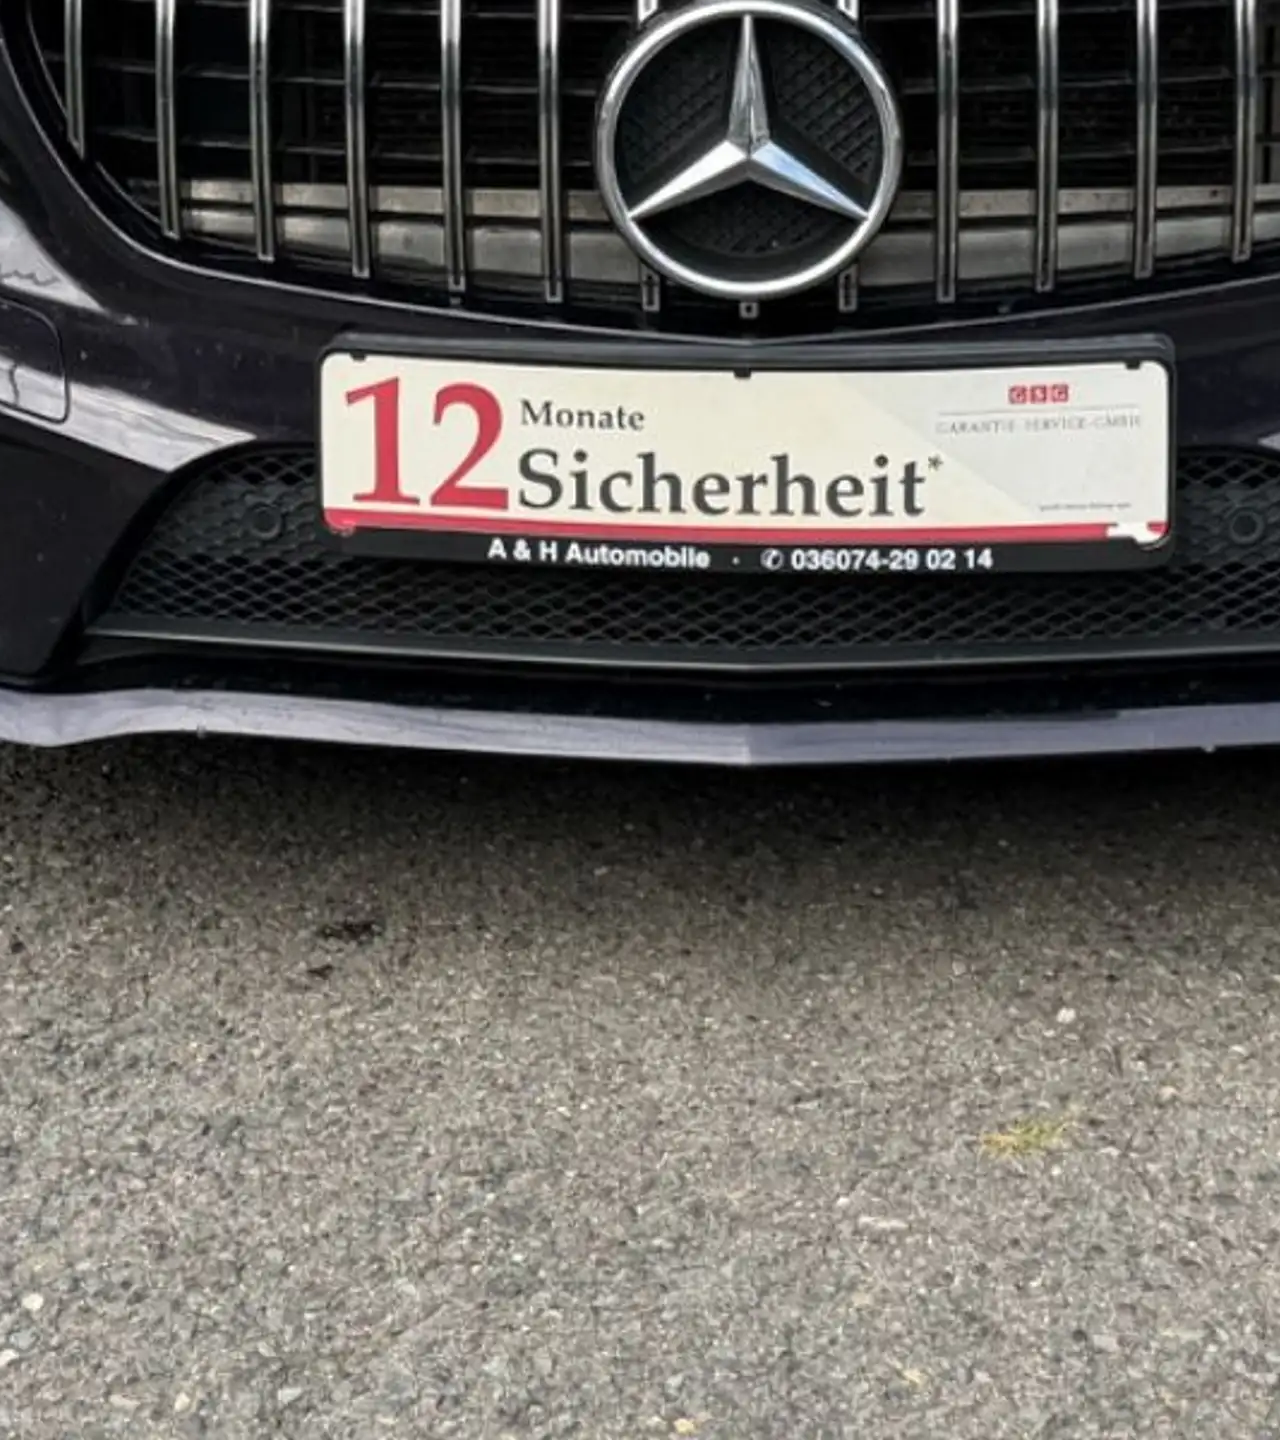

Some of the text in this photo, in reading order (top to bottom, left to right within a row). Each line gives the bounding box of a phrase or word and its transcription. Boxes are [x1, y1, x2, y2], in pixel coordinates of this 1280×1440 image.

[521, 399, 645, 431] Monate
[345, 377, 509, 510] 12
[488, 537, 711, 569] A & H Automobile
[790, 547, 994, 571] 036074-29 02 14
